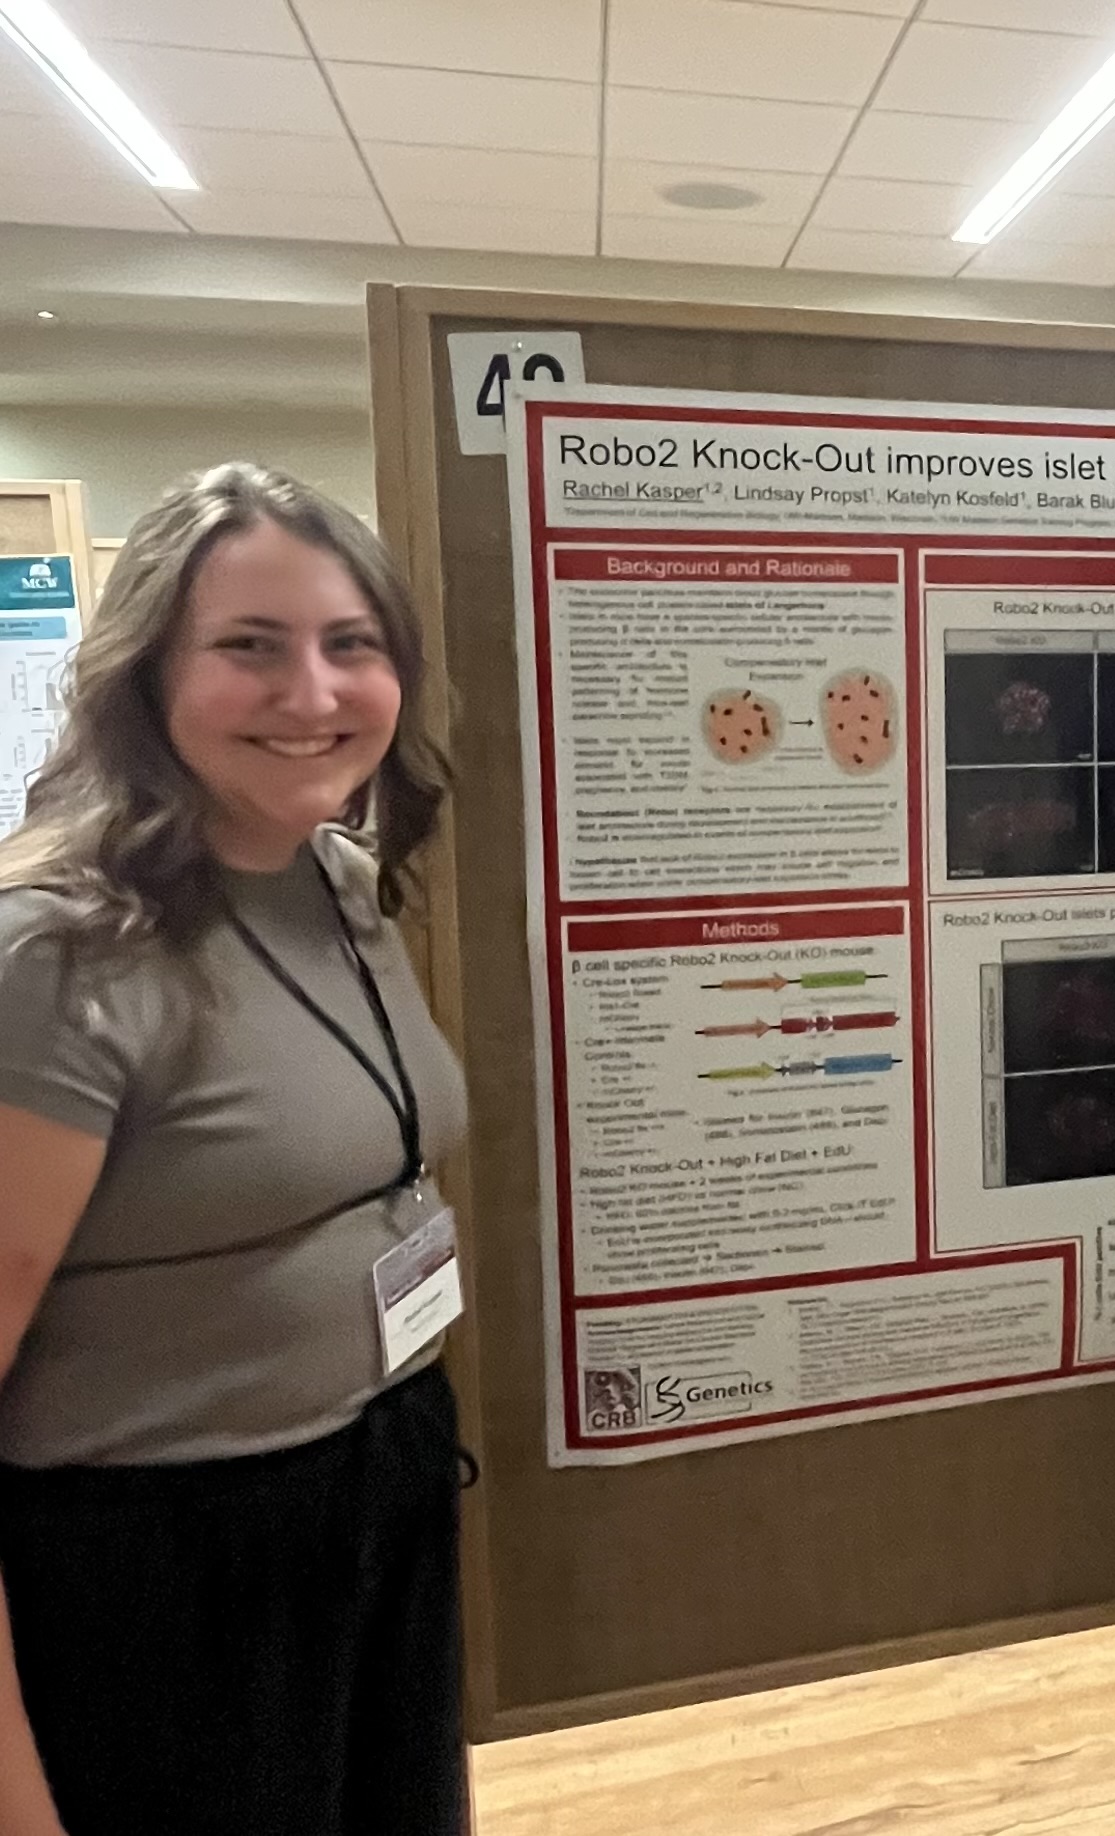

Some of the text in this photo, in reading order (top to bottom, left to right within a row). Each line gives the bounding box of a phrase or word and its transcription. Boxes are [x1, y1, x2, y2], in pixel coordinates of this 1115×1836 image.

[559, 434, 679, 468] Robo2
[692, 438, 876, 474] Knock-Out
[887, 446, 1034, 483] improves
[1044, 451, 1107, 480] islet
[562, 479, 630, 498] Rachel
[733, 485, 804, 504] Lindsay
[886, 488, 951, 508] Katelyn
[1037, 493, 1085, 508] Barak
[606, 556, 852, 578] Background and Rationale
[993, 601, 1039, 615] Robo2
[1042, 602, 1114, 615] Knock-Out
[943, 911, 990, 927] Robo2
[994, 908, 1068, 925] Knock-Out
[701, 921, 780, 939] Methods
[585, 959, 609, 972] cell
[613, 956, 667, 973] specific
[670, 952, 716, 967] Robo2
[719, 949, 792, 964] Knock-Out
[830, 945, 875, 957] mouse
[579, 1165, 626, 1179] Robo2
[686, 1378, 774, 1403] Genetics
[591, 1409, 637, 1430] CRB
